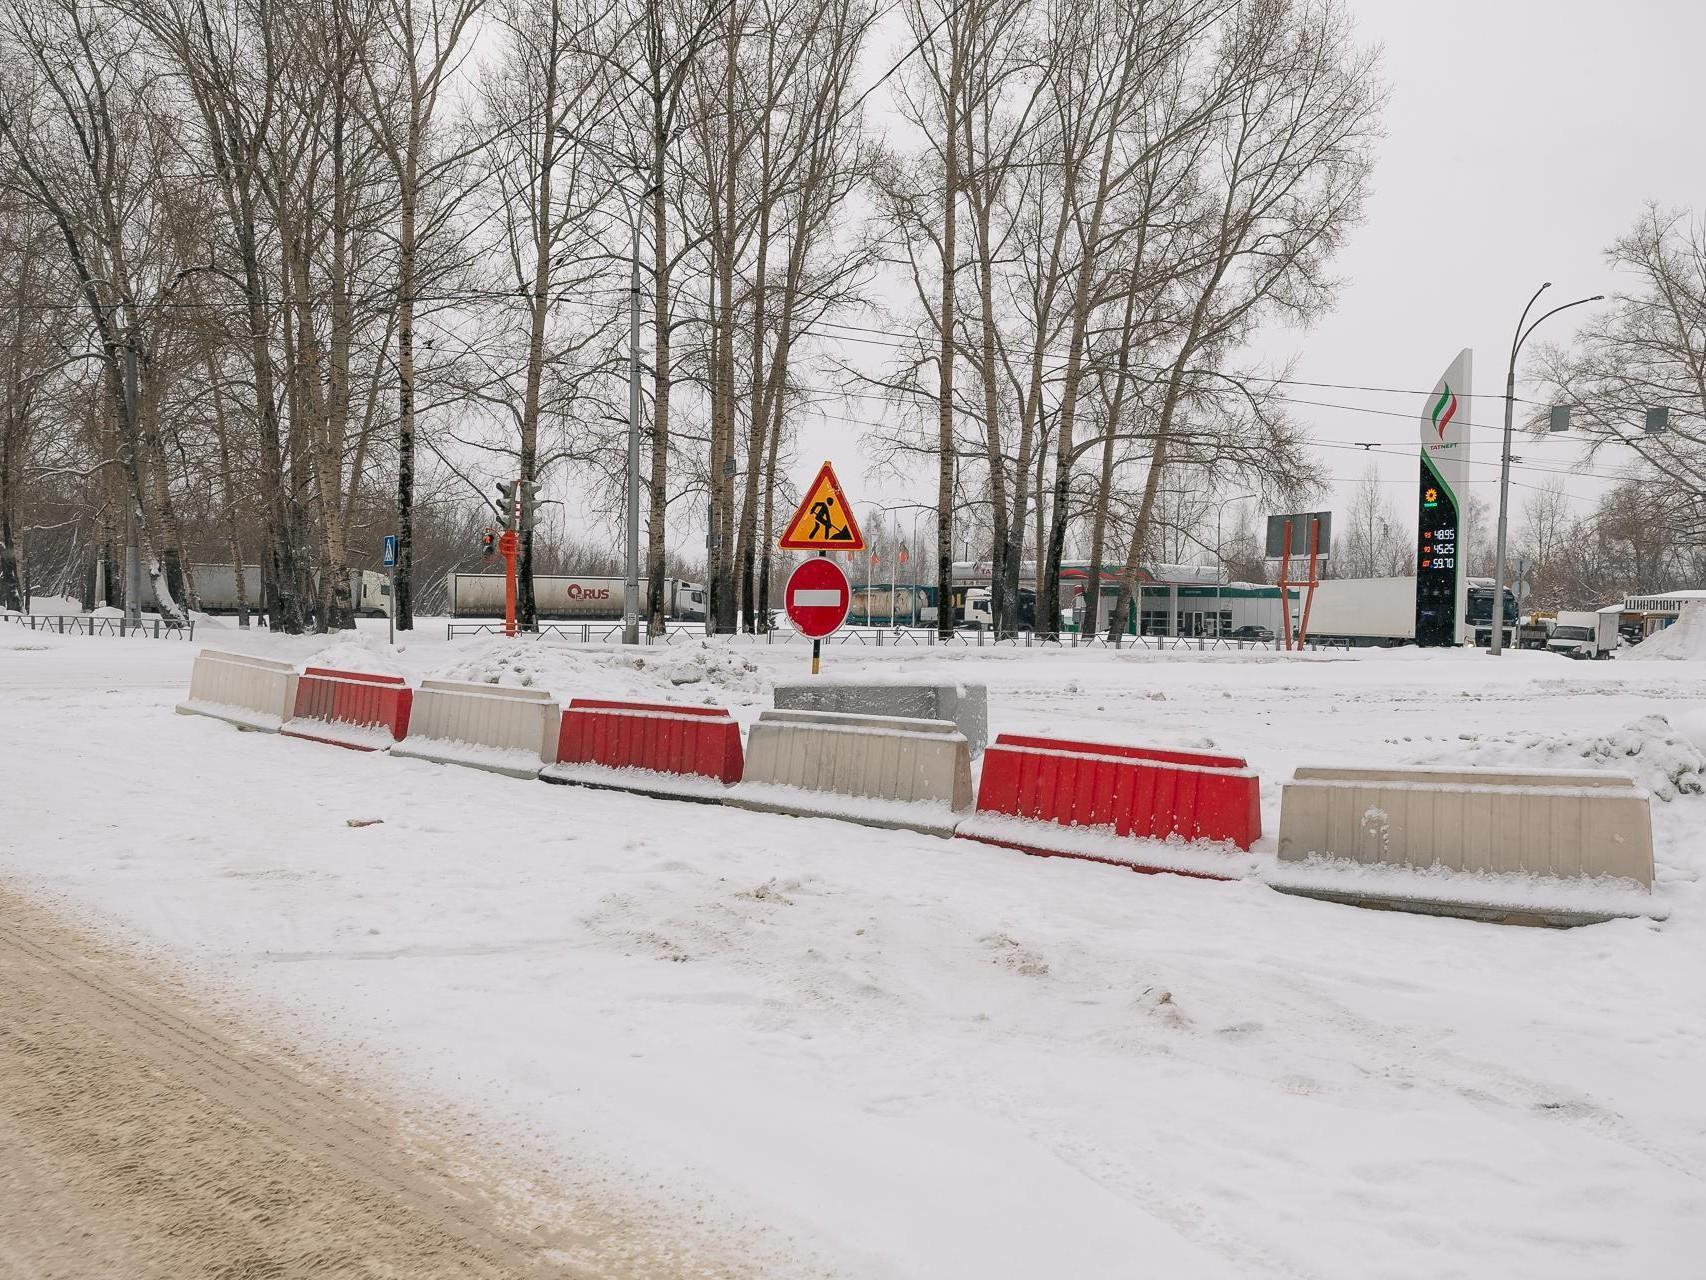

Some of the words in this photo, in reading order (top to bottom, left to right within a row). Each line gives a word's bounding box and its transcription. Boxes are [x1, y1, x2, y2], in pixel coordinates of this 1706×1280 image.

[1434, 529, 1455, 540] 48.95
[1433, 543, 1454, 554] 45.25
[1433, 558, 1454, 568] 59.70
[1625, 600, 1692, 610] ШИНОМОНТ
